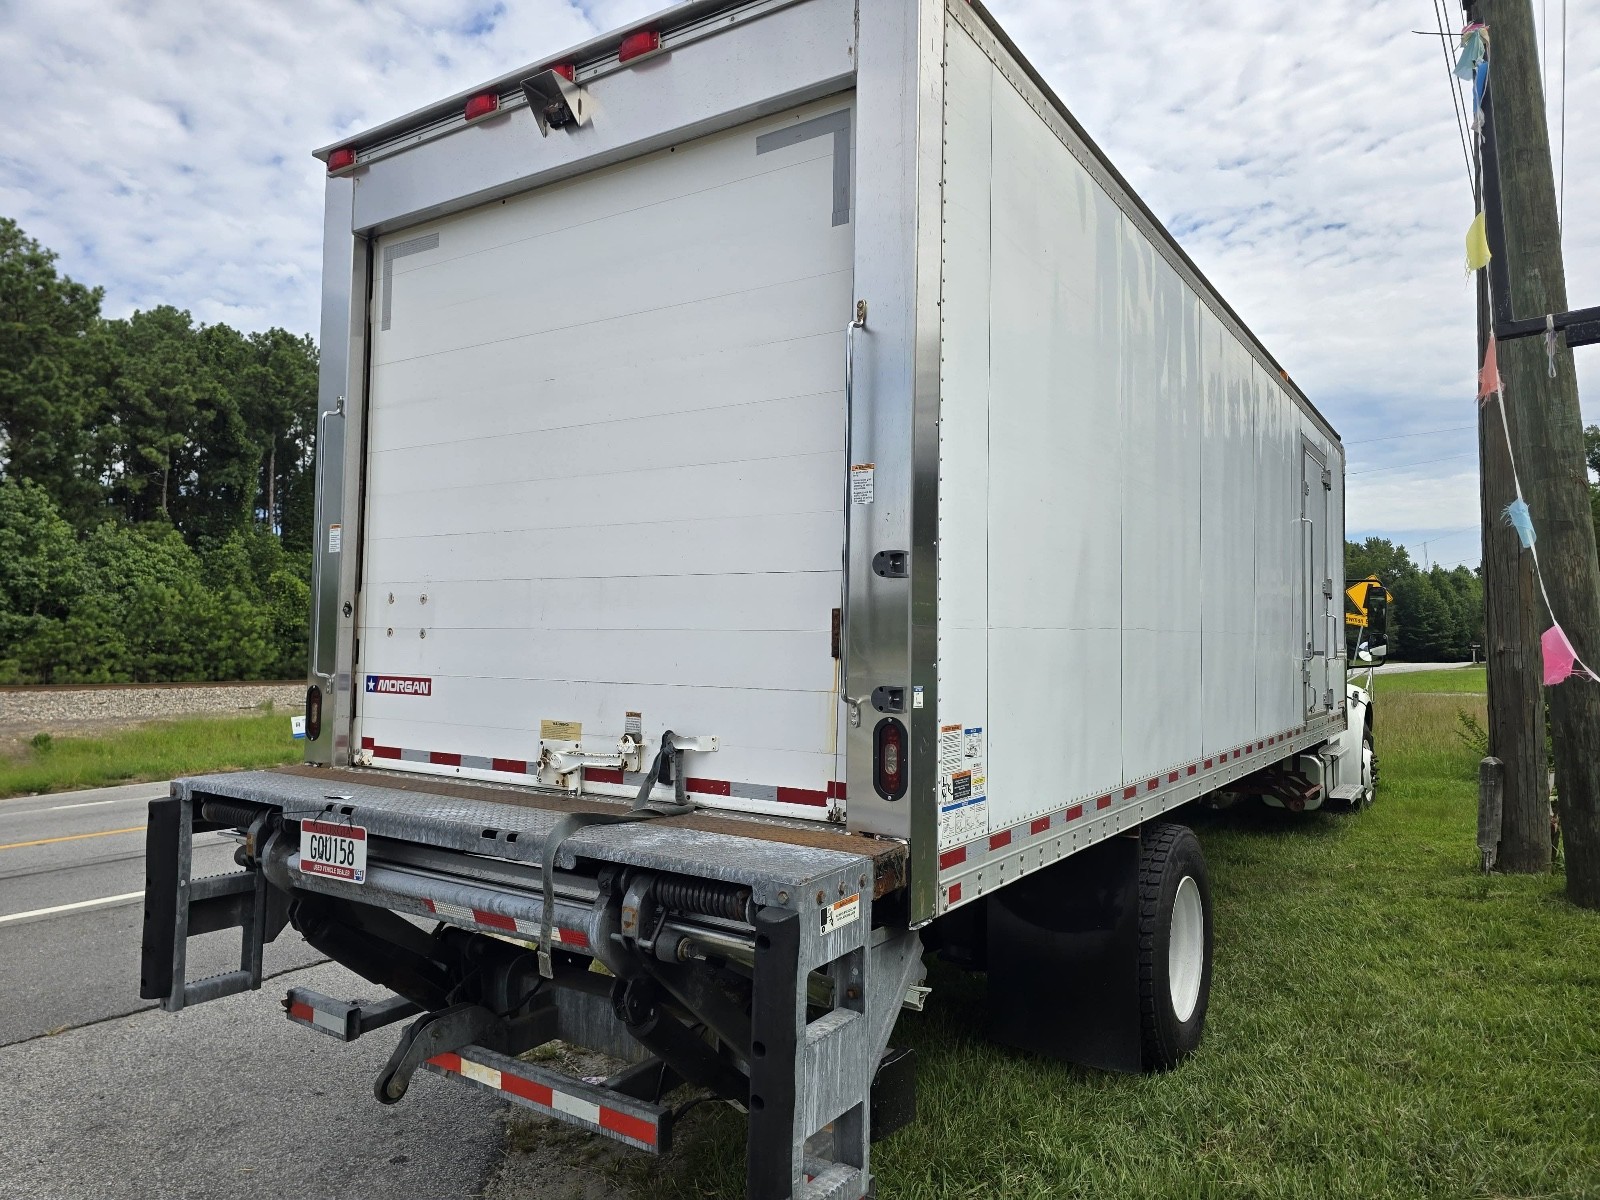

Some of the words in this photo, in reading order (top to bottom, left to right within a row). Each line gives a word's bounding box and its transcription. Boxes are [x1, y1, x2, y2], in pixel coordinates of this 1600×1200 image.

[377, 680, 429, 693] MORGAN
[310, 834, 354, 866] GQU158
[322, 866, 337, 874] VEHICLE
[337, 868, 351, 876] DEALER
